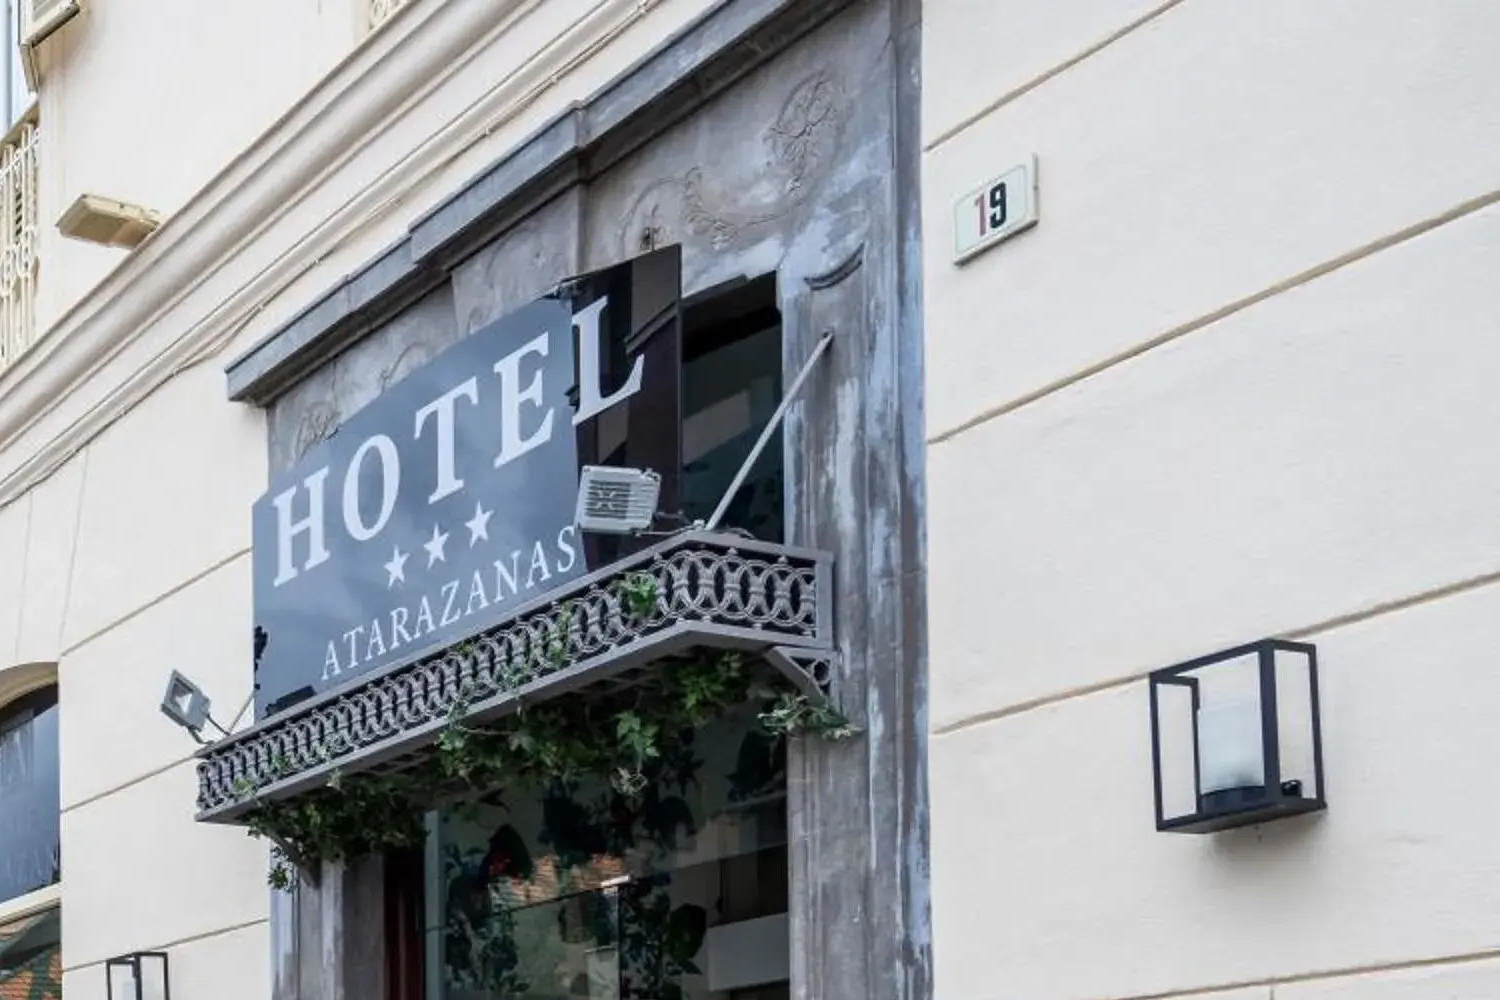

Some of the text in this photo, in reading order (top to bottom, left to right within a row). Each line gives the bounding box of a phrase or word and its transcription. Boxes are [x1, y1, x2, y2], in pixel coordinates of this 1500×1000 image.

[974, 181, 1007, 237] 19
[273, 295, 645, 588] HOTEL
[321, 525, 578, 683] ATARAZANAS
